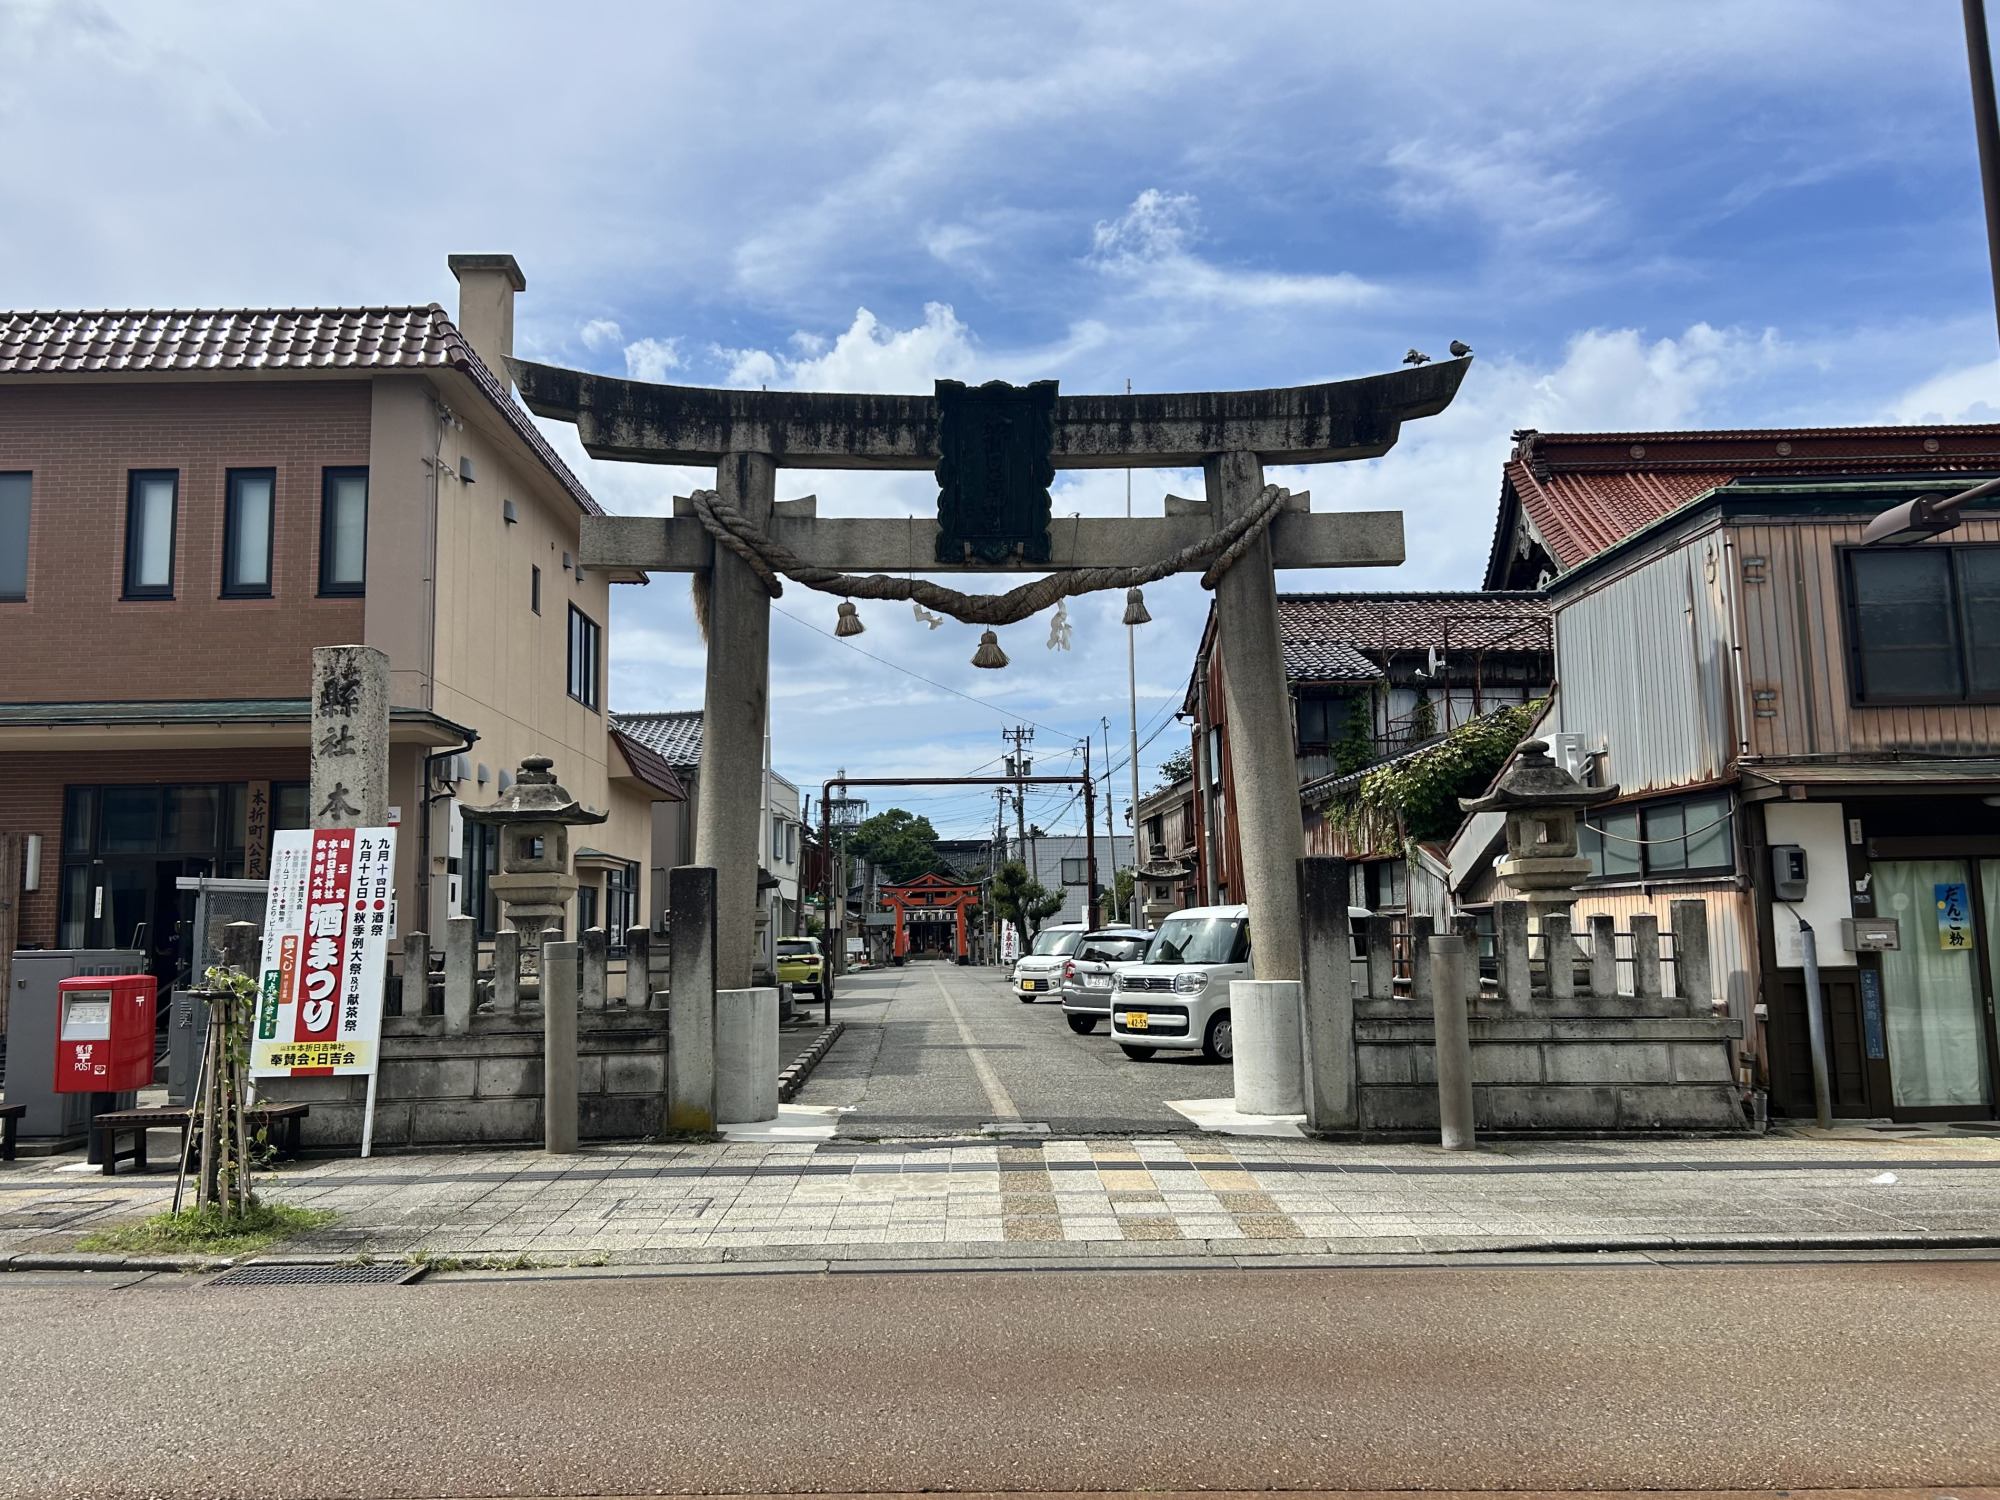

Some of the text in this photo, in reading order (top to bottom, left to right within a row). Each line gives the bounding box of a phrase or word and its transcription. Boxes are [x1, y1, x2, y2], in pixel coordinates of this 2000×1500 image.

[248, 788, 267, 879] 本折町公民
[311, 839, 327, 899] 秋季例大祭
[324, 839, 338, 899] 本折日吉神社
[335, 839, 351, 899] 山王宮
[371, 838, 390, 936] 九月十四日 酒祭
[344, 838, 373, 1031] 九月十七日 秋季例大祭及び献茶祭
[1945, 886, 1965, 946] だんご粉
[282, 938, 295, 971] 富くじ
[302, 902, 345, 1033] 酒まつり
[74, 1062, 92, 1071] POST
[75, 1044, 93, 1055] 郵便
[270, 1052, 355, 1066] 奉賛会・日吉会
[297, 1043, 346, 1052] 本折日吉神社
